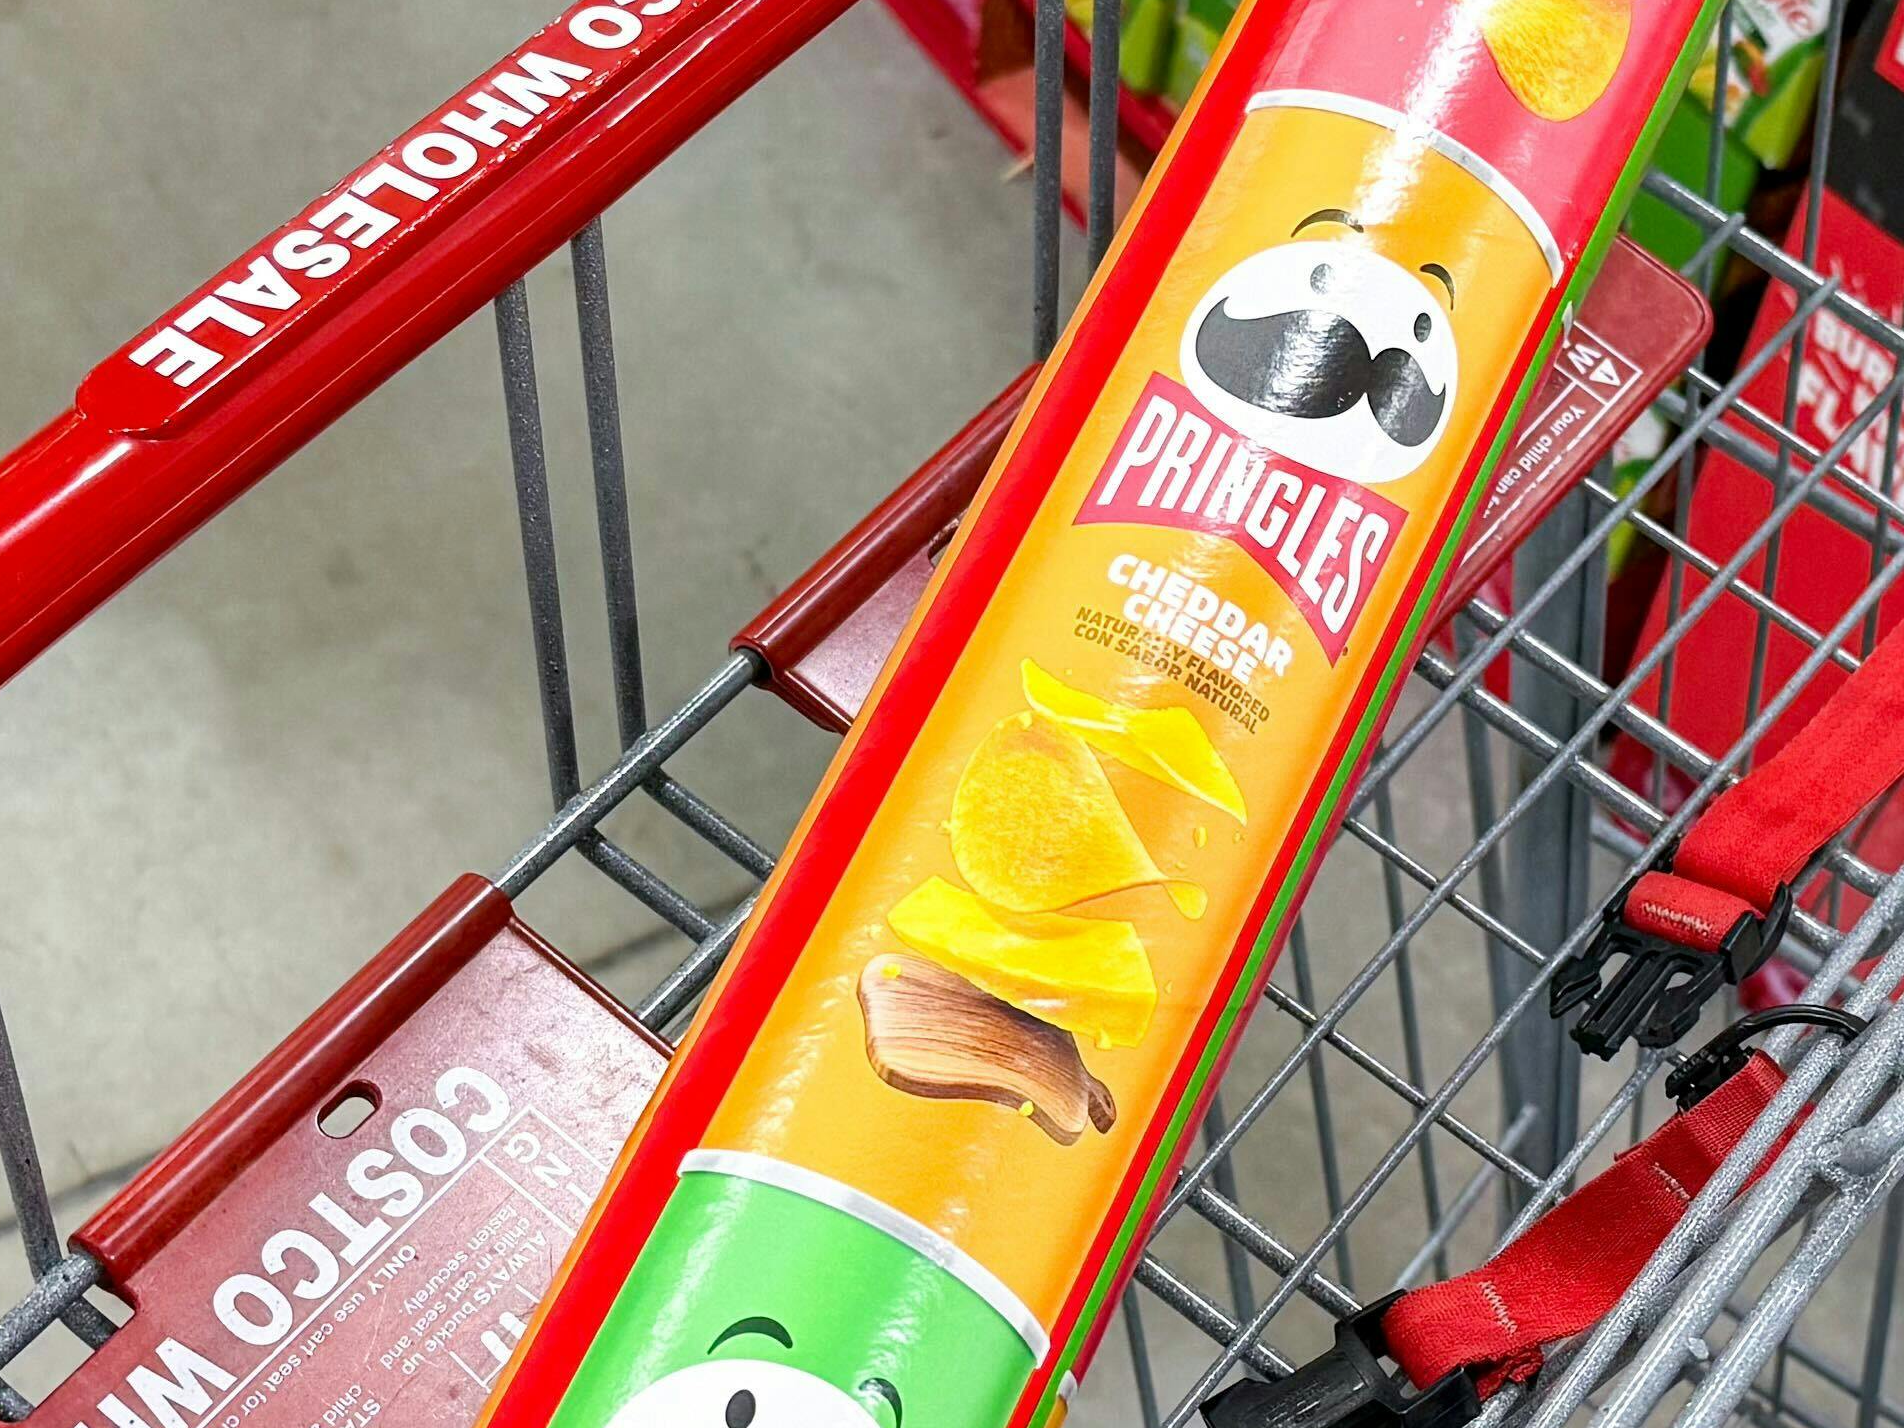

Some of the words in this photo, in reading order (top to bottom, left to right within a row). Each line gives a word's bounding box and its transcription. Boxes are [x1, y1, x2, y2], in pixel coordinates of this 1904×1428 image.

[128, 51, 593, 388] WHOLESALE
[1553, 404, 1587, 437] Your
[1520, 435, 1553, 472] child
[1495, 469, 1522, 497] can
[1097, 395, 1390, 635] PRINGLES
[1107, 553, 1293, 677] CHEDDAR
[1123, 592, 1263, 685] CHEESE
[1074, 624, 1113, 656] CON
[1114, 638, 1184, 683] SABOR
[1184, 673, 1263, 734] NATURAL
[1185, 656, 1270, 723] FLAVORED
[212, 1065, 511, 1347] COSTCO
[467, 1205, 518, 1250] fasten
[494, 1217, 530, 1254] child
[367, 1244, 417, 1295] ONLY
[473, 1230, 547, 1305] ALWAYS
[476, 1253, 494, 1270] in
[398, 1250, 469, 1315] securely.
[446, 1270, 477, 1303] cart
[334, 1291, 366, 1323] use
[410, 1301, 447, 1337] seat
[299, 1322, 334, 1357] cart
[426, 1302, 478, 1353] buckle
[379, 1335, 412, 1370] and
[402, 1352, 427, 1375] up
[263, 1354, 302, 1392] seat
[241, 1390, 267, 1416] for
[323, 1384, 362, 1426] child
